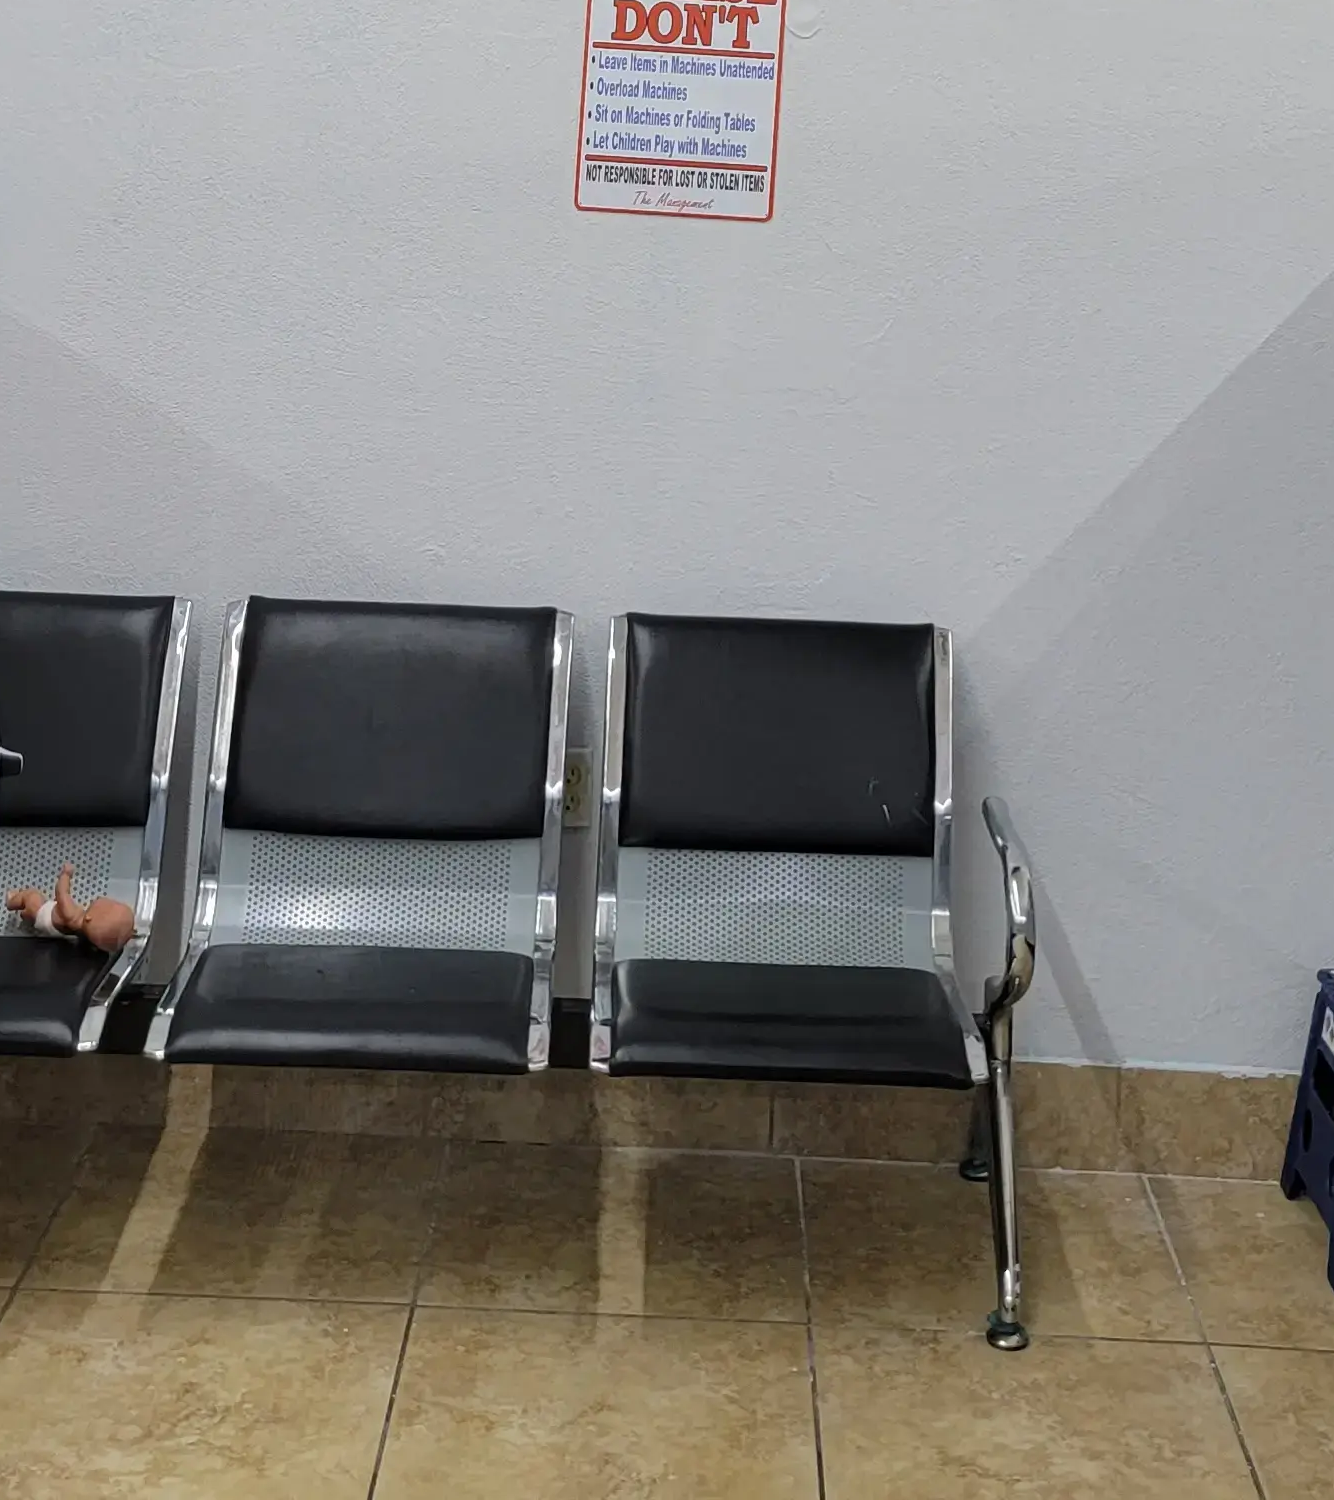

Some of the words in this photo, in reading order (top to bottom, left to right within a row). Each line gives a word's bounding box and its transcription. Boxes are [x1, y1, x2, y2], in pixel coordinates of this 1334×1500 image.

[611, 0, 759, 49] DON'T
[599, 54, 627, 71] Leave
[630, 55, 657, 73] Items
[659, 57, 668, 73] in
[671, 57, 716, 76] Machines
[719, 60, 775, 81] Unattended
[597, 80, 639, 98] Overload
[642, 81, 687, 101] Machines
[594, 104, 608, 123] Sit
[610, 108, 623, 123] on
[625, 107, 671, 127] Machines
[673, 113, 685, 127] or
[686, 110, 721, 135] Folding
[724, 112, 755, 132] Tables
[593, 132, 609, 150] Let
[611, 132, 651, 152] Children
[654, 135, 675, 158] Play
[677, 136, 698, 155] with
[701, 137, 747, 158] Machines
[585, 164, 602, 183] NOT
[603, 164, 656, 187] RESPONSIBLE
[658, 169, 673, 187] FOR
[675, 170, 696, 188] LOST
[697, 171, 708, 190] OR
[709, 171, 740, 191] STOLEN
[741, 173, 765, 193] ITEMS
[632, 191, 652, 206] The
[654, 192, 715, 213] Management
